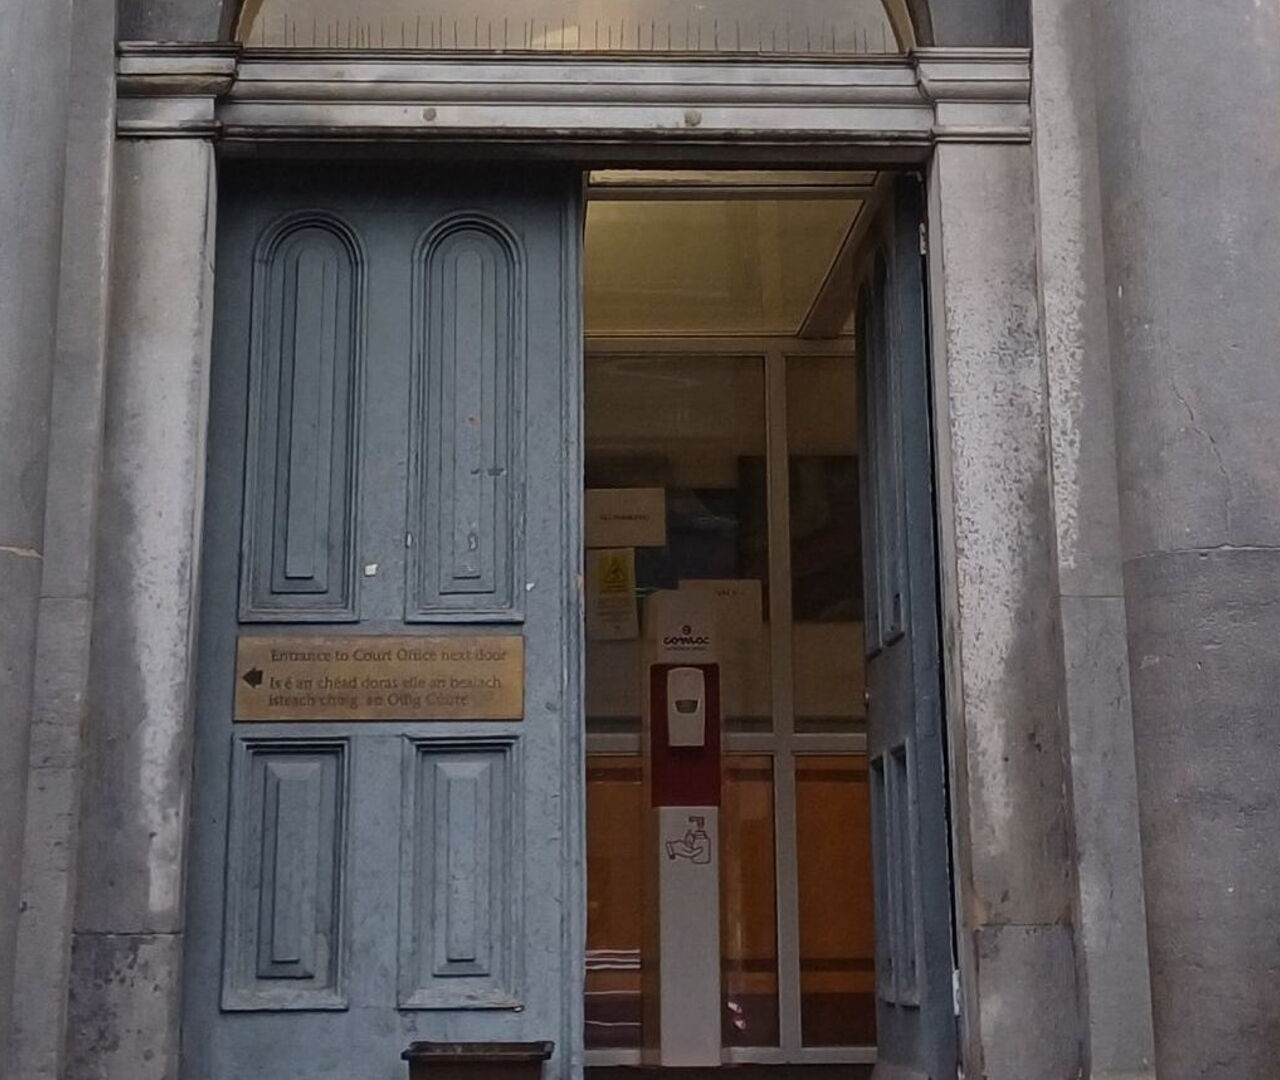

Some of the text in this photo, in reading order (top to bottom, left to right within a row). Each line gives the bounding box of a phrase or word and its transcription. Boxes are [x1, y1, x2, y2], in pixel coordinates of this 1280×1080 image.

[271, 647, 507, 662] Entrance to Court Office next door
[296, 679, 312, 689] an
[361, 675, 398, 689] doras
[430, 678, 446, 689] an
[450, 675, 501, 689] bealach
